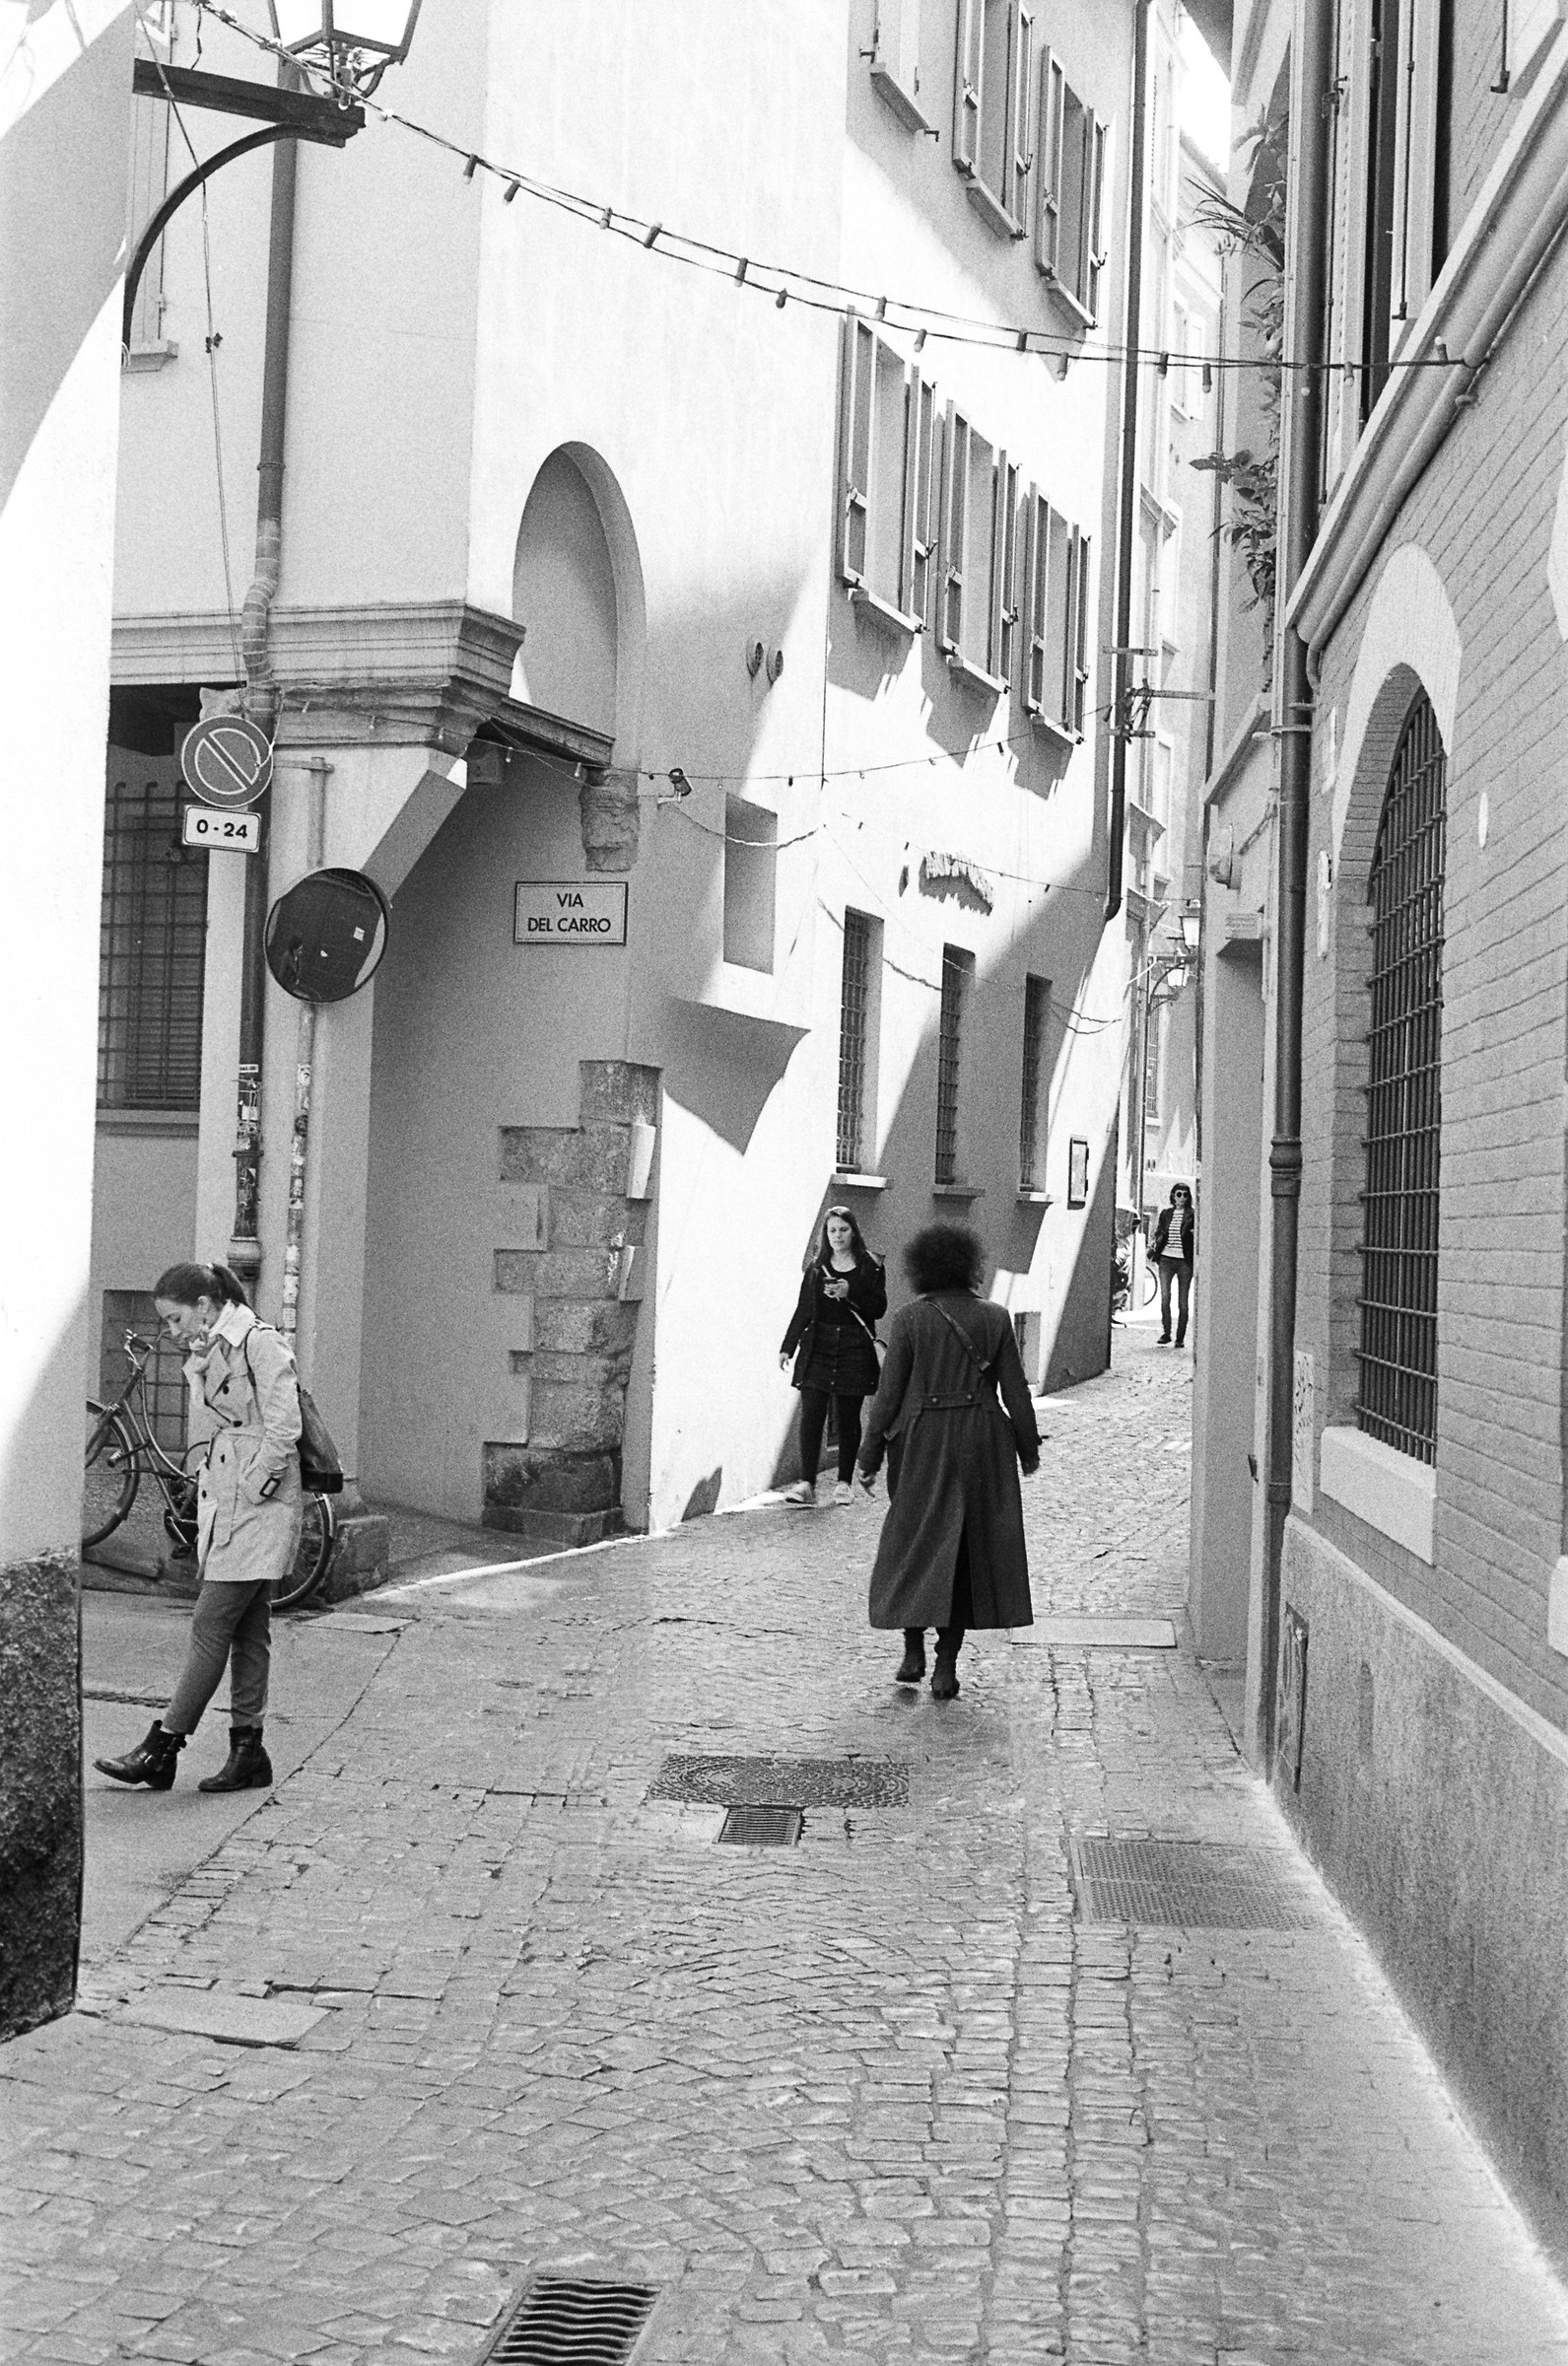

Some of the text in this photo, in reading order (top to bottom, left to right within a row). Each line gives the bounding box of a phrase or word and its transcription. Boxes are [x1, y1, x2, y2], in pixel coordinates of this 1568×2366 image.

[223, 822, 247, 838] 24
[557, 892, 584, 908] VIA
[527, 917, 611, 933] DEL CARRO
